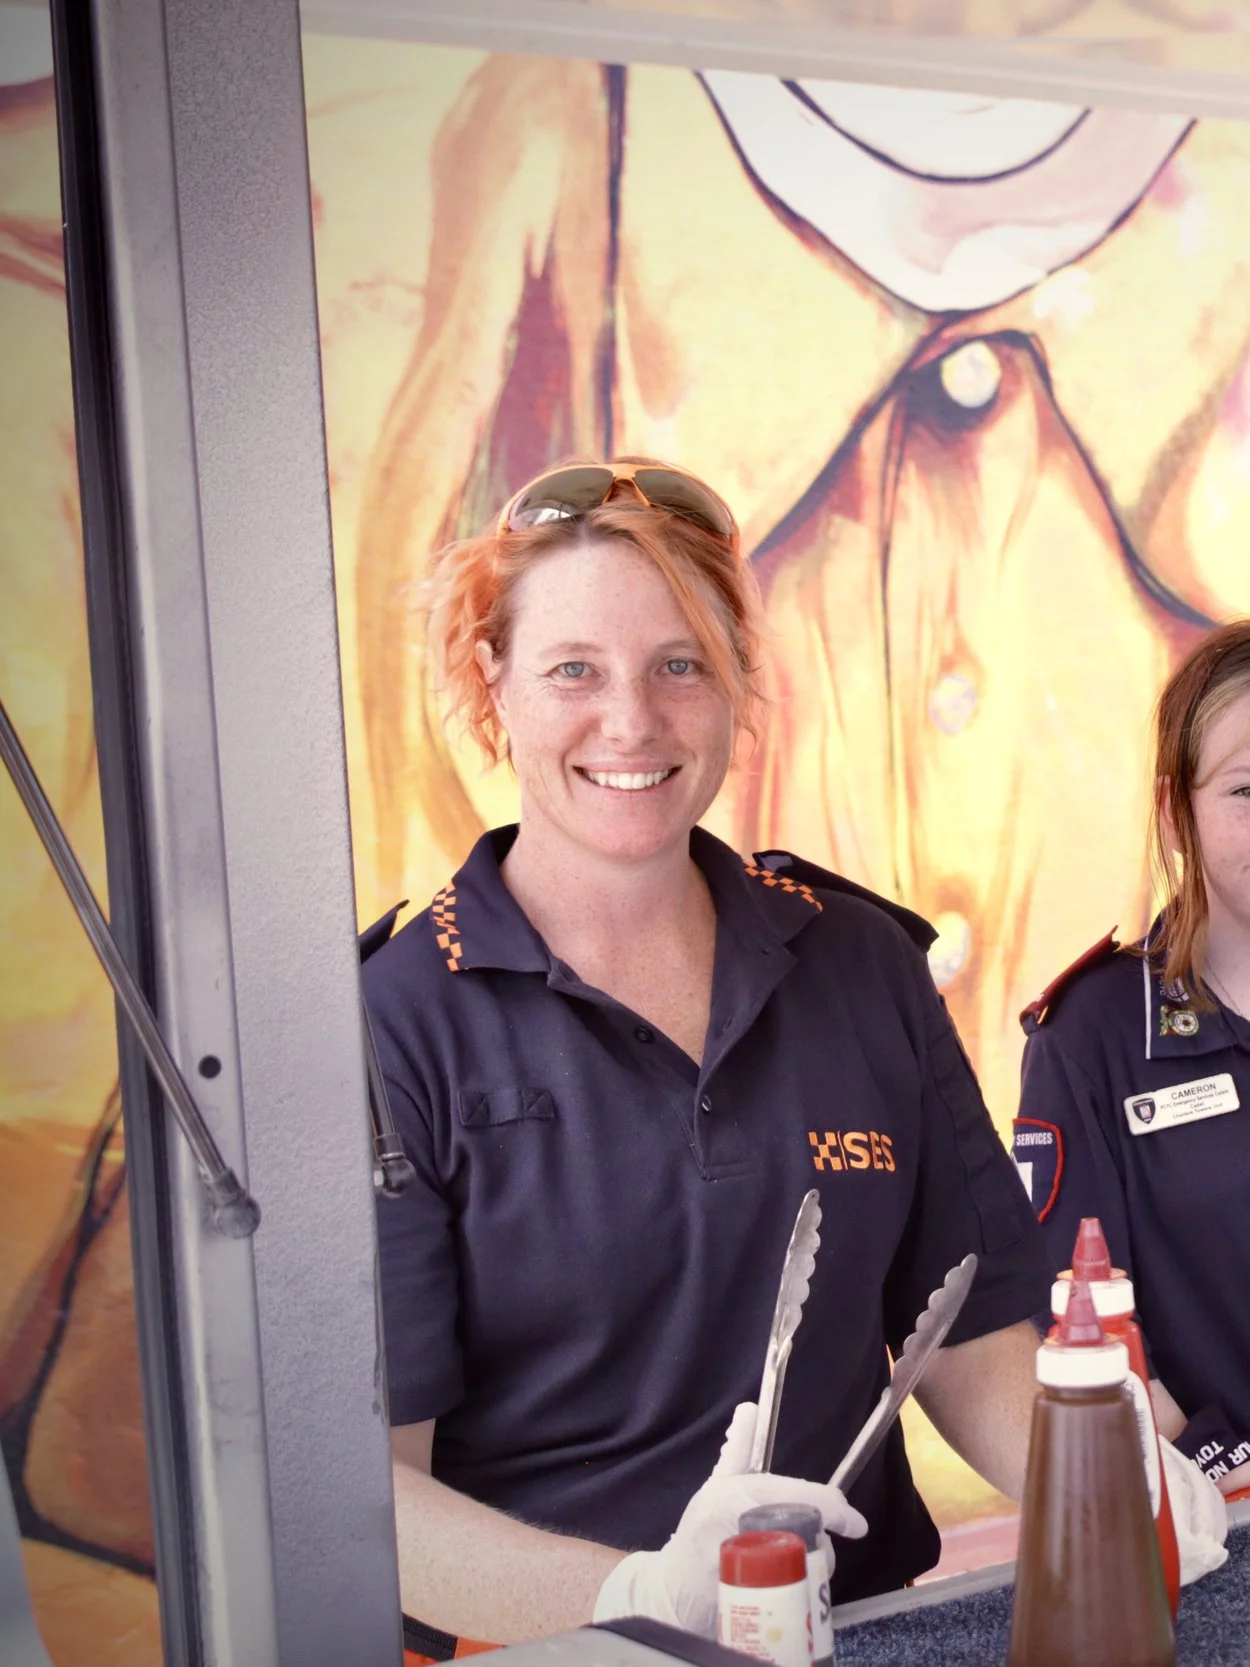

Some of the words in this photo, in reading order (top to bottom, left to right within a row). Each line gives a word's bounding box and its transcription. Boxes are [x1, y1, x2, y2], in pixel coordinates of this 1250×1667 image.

[1171, 1082, 1216, 1100] CAMERON
[1016, 1131, 1053, 1147] SERVICES
[843, 1131, 896, 1172] SES
